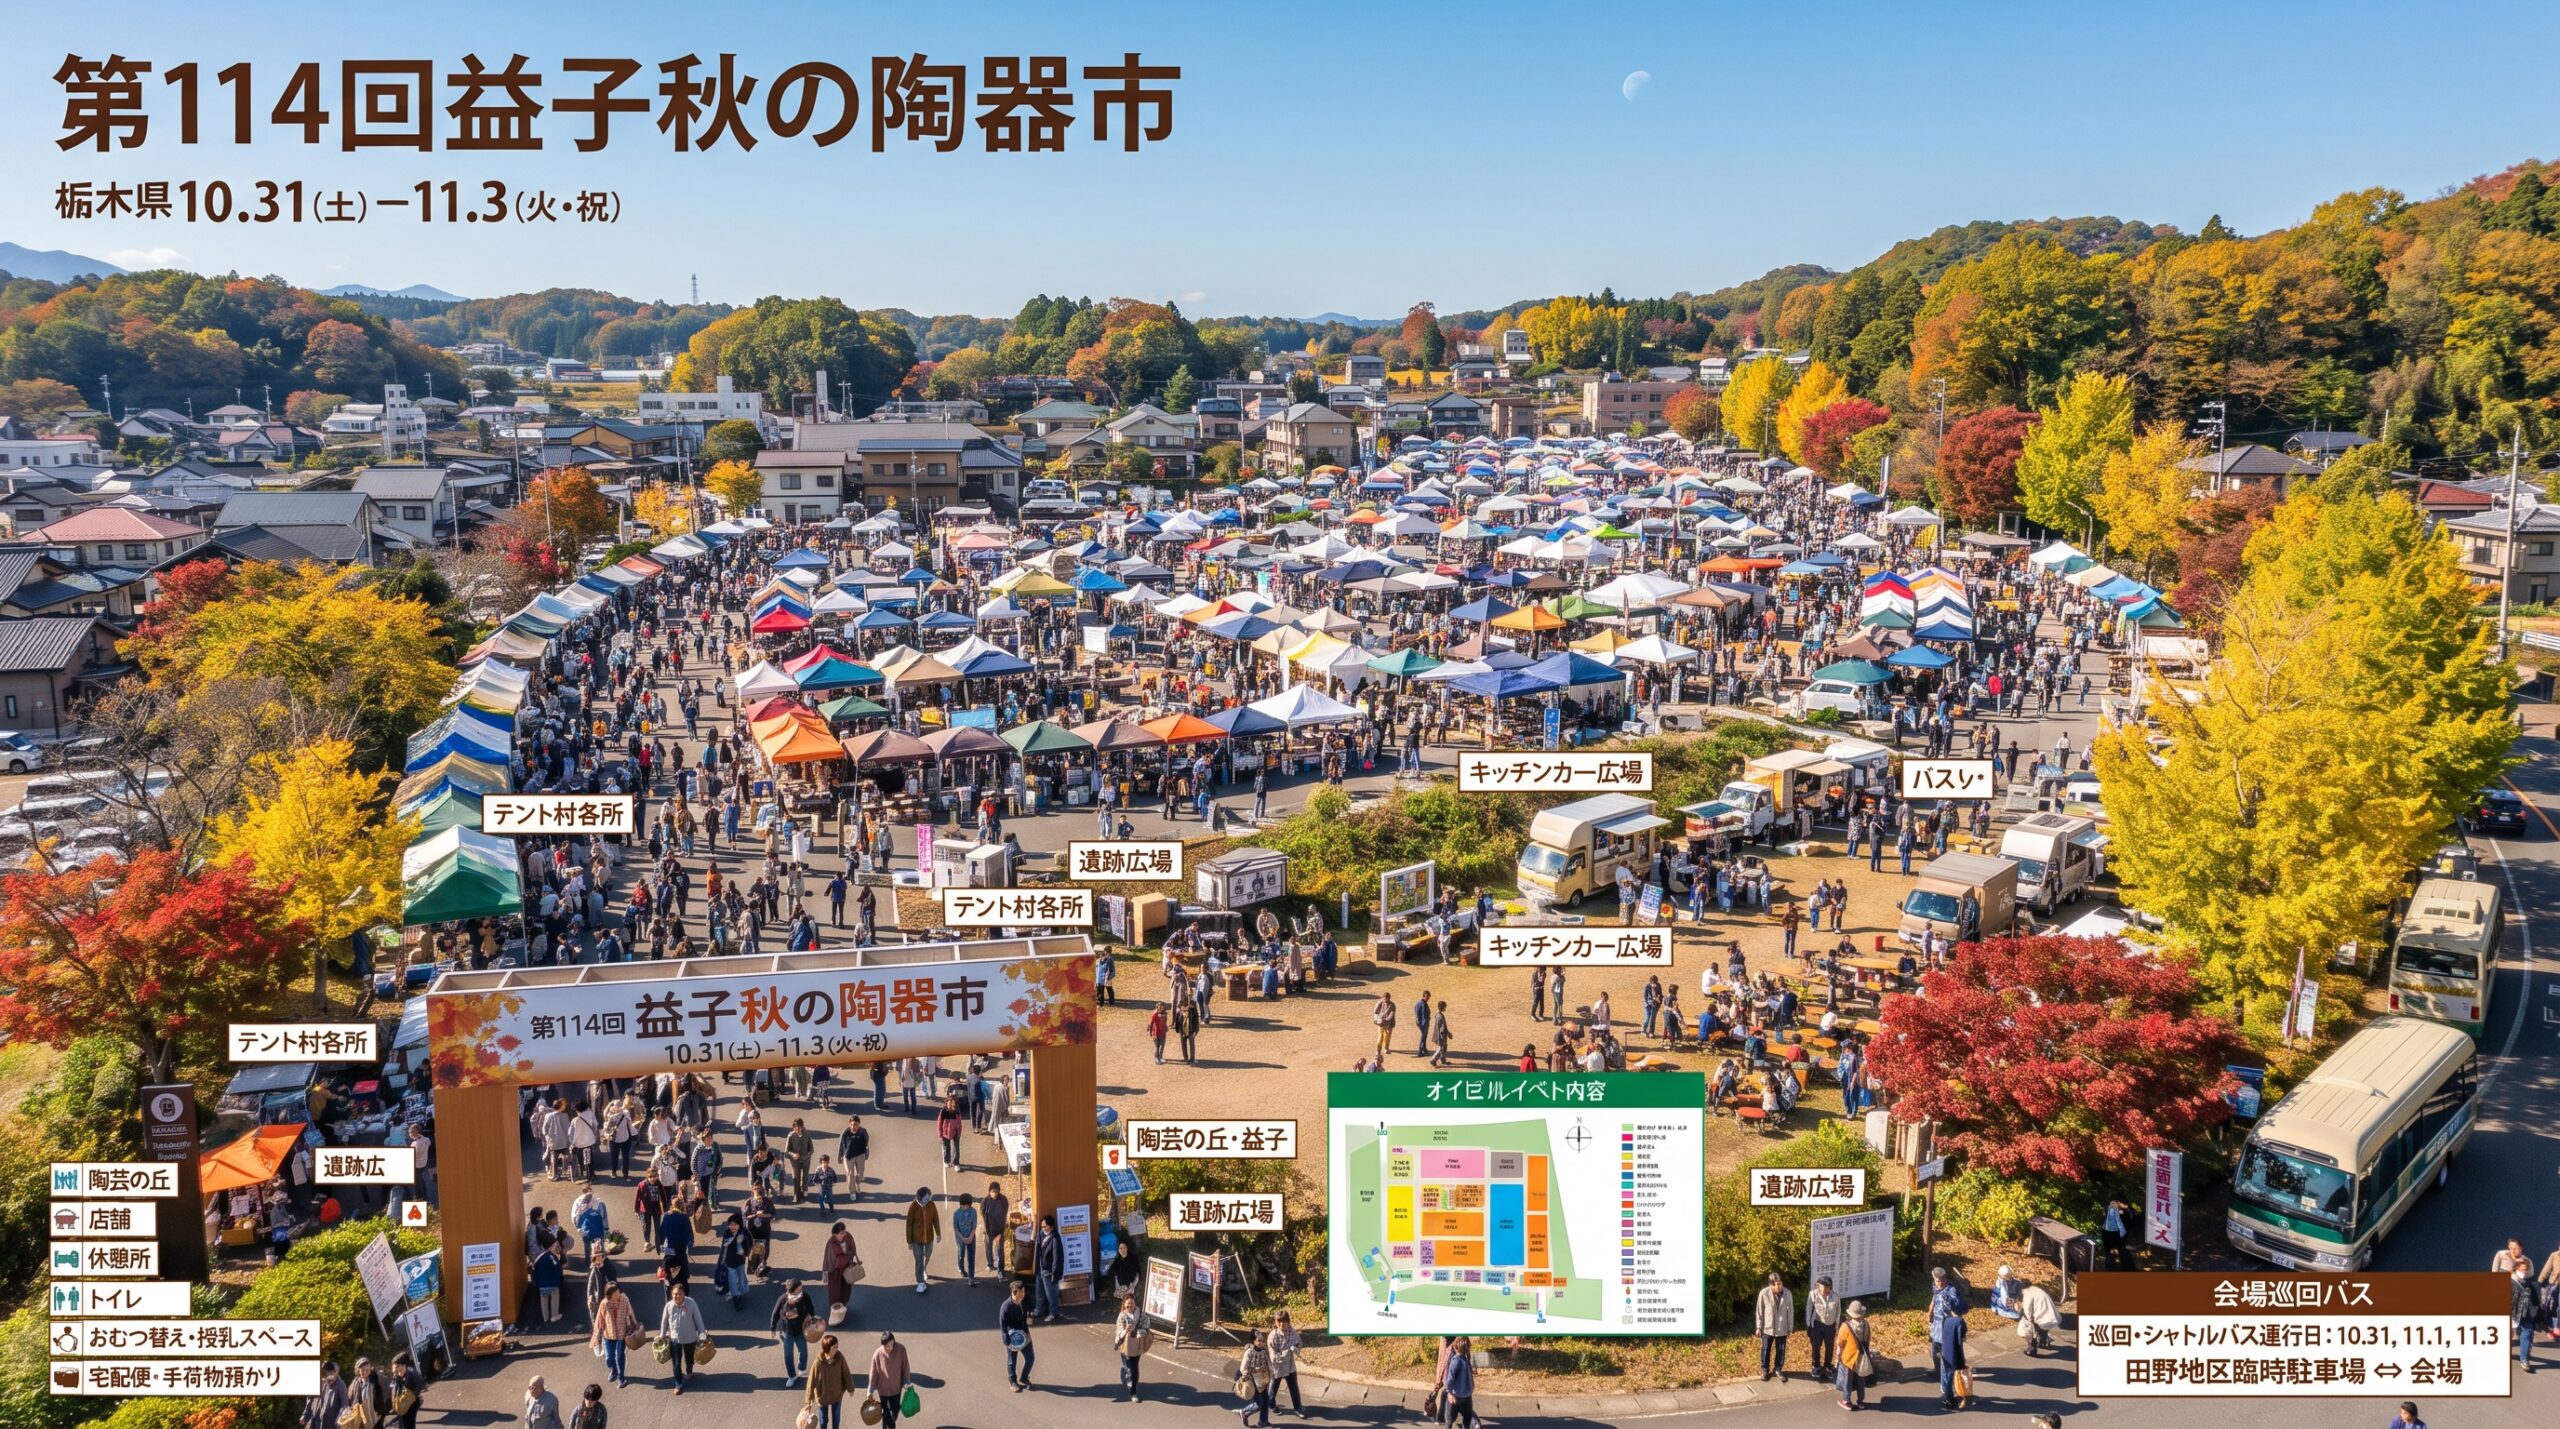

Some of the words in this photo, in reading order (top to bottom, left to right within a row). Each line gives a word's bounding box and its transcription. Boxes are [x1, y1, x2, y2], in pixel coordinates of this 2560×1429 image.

[531, 1012, 626, 1040] 第114回
[635, 976, 988, 1039] 益子秋の陶器市
